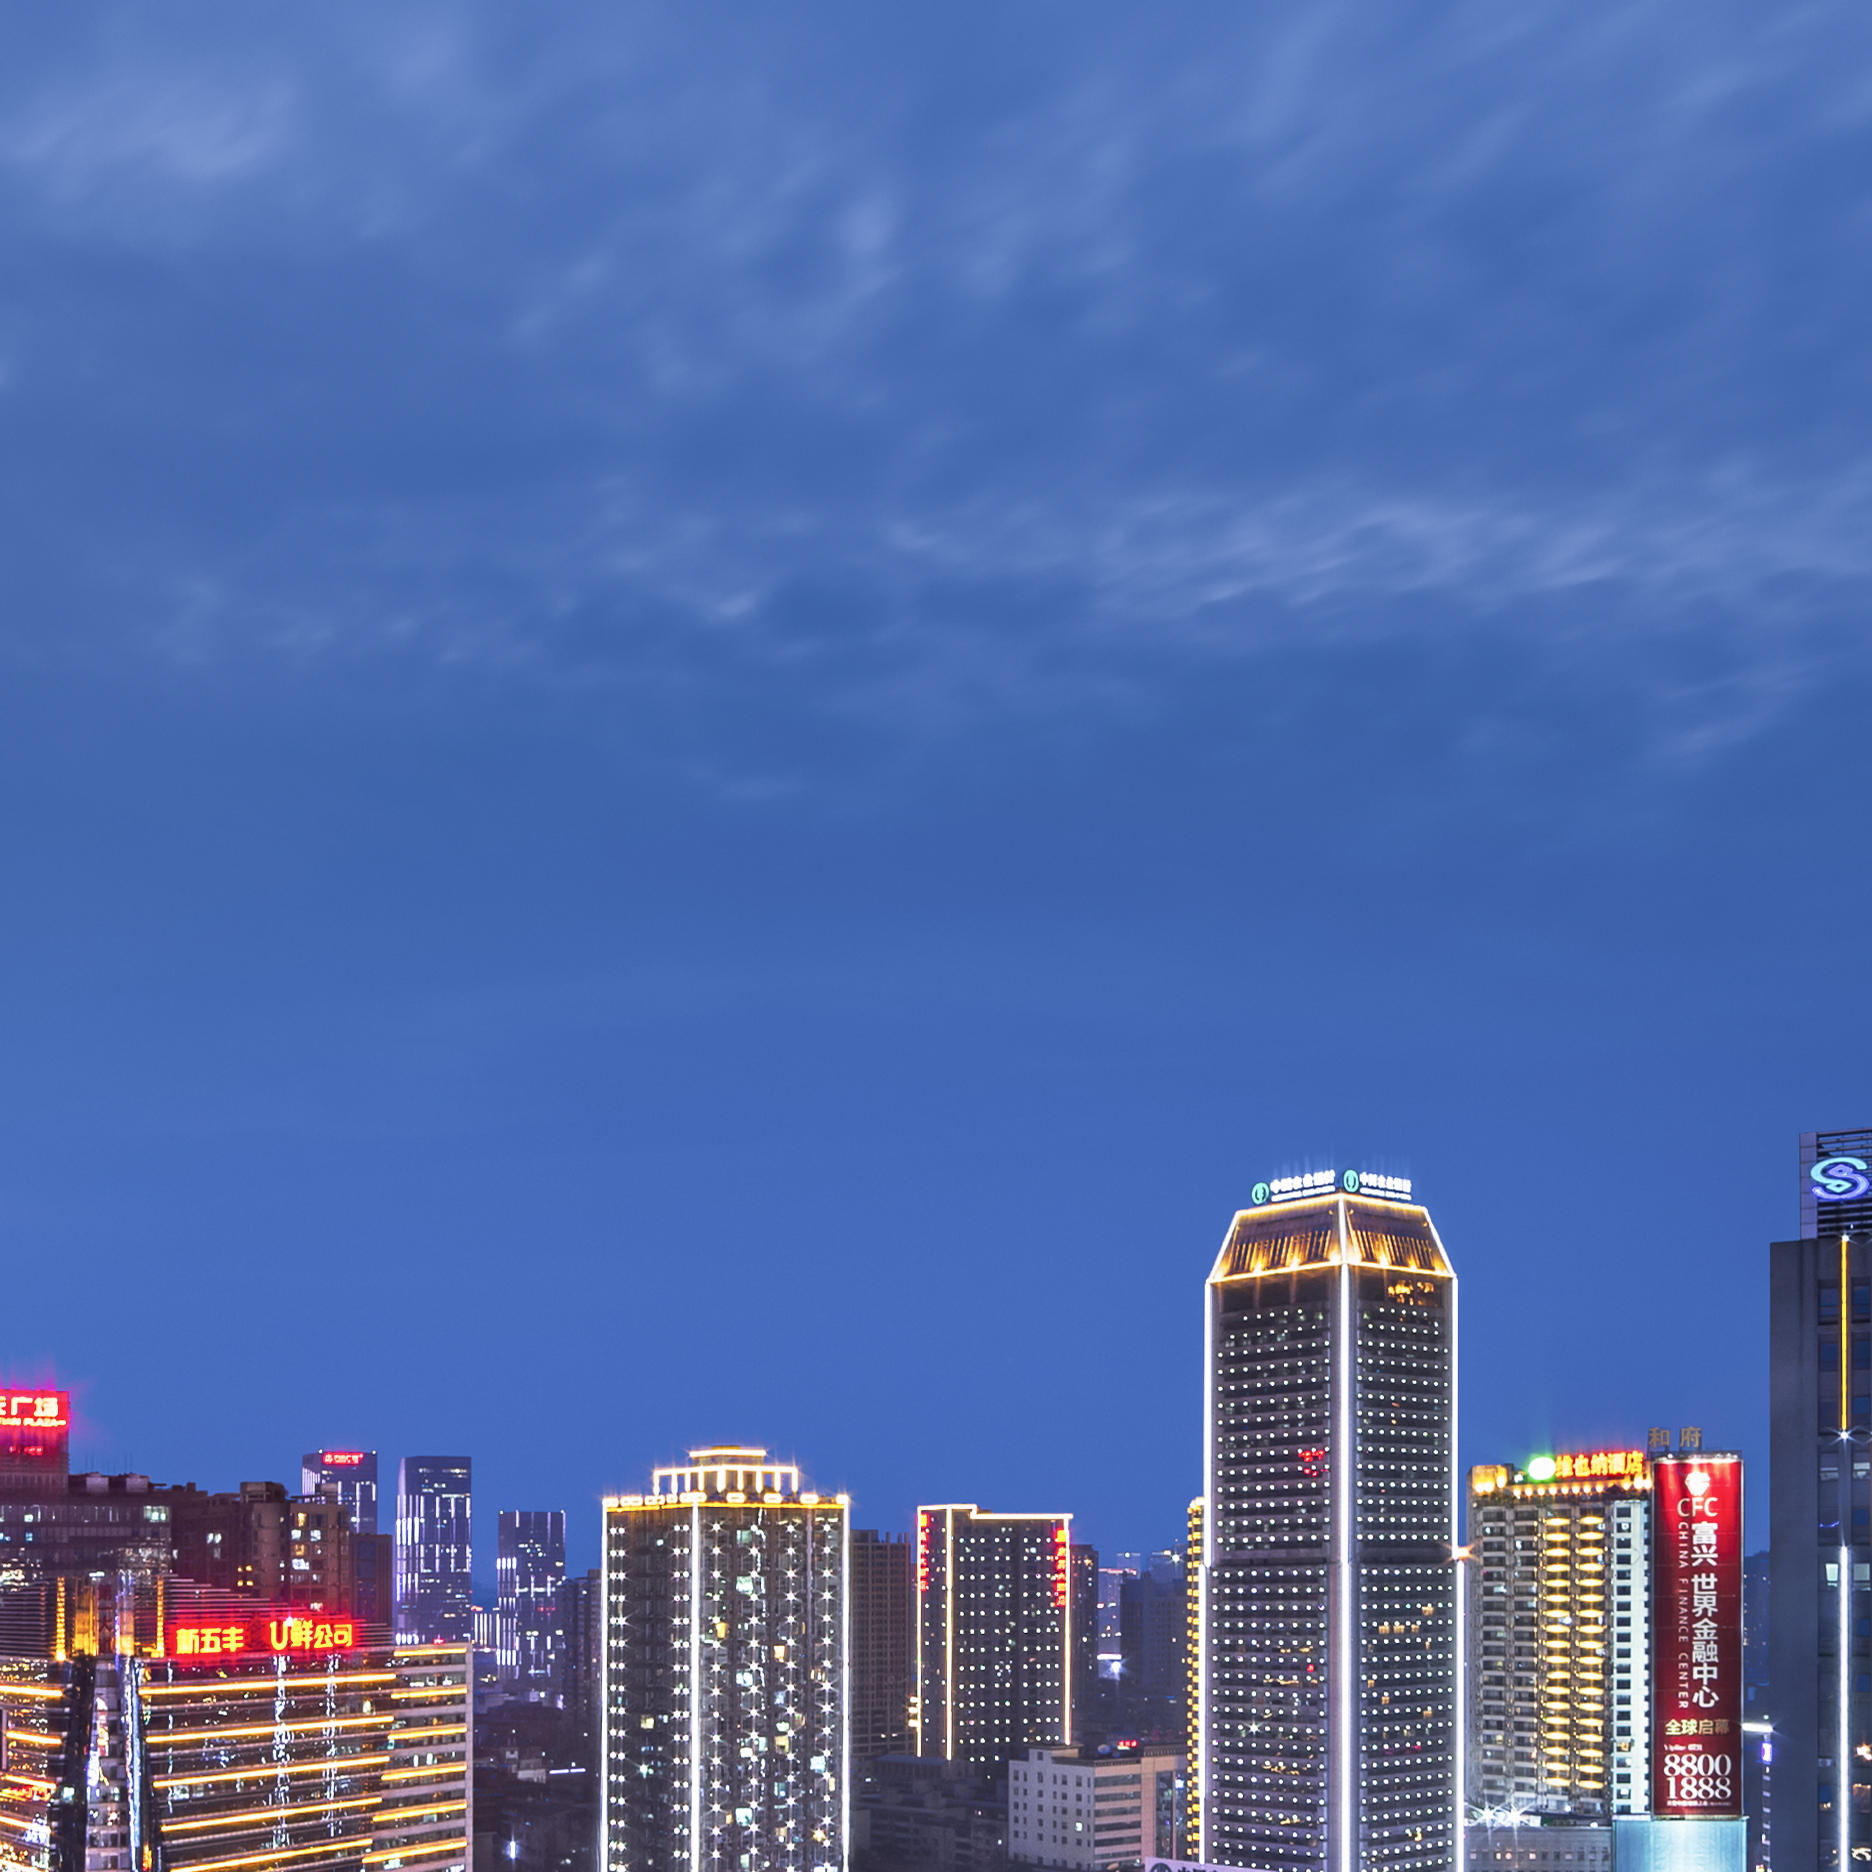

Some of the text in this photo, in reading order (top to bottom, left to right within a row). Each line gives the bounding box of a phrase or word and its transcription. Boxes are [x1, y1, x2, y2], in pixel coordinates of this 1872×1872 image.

[1648, 1426, 1702, 1449] 和府
[1555, 1450, 1645, 1478] 维也纳酒店
[1677, 1497, 1719, 1518] CFC
[1678, 1522, 1689, 1709] CHINA FINANCE CENTER
[1690, 1520, 1720, 1709] 富兴 世界金融中心
[176, 1626, 244, 1655] 新五丰
[1664, 1753, 1732, 1777] 8800
[1666, 1776, 1732, 1800] 1888
